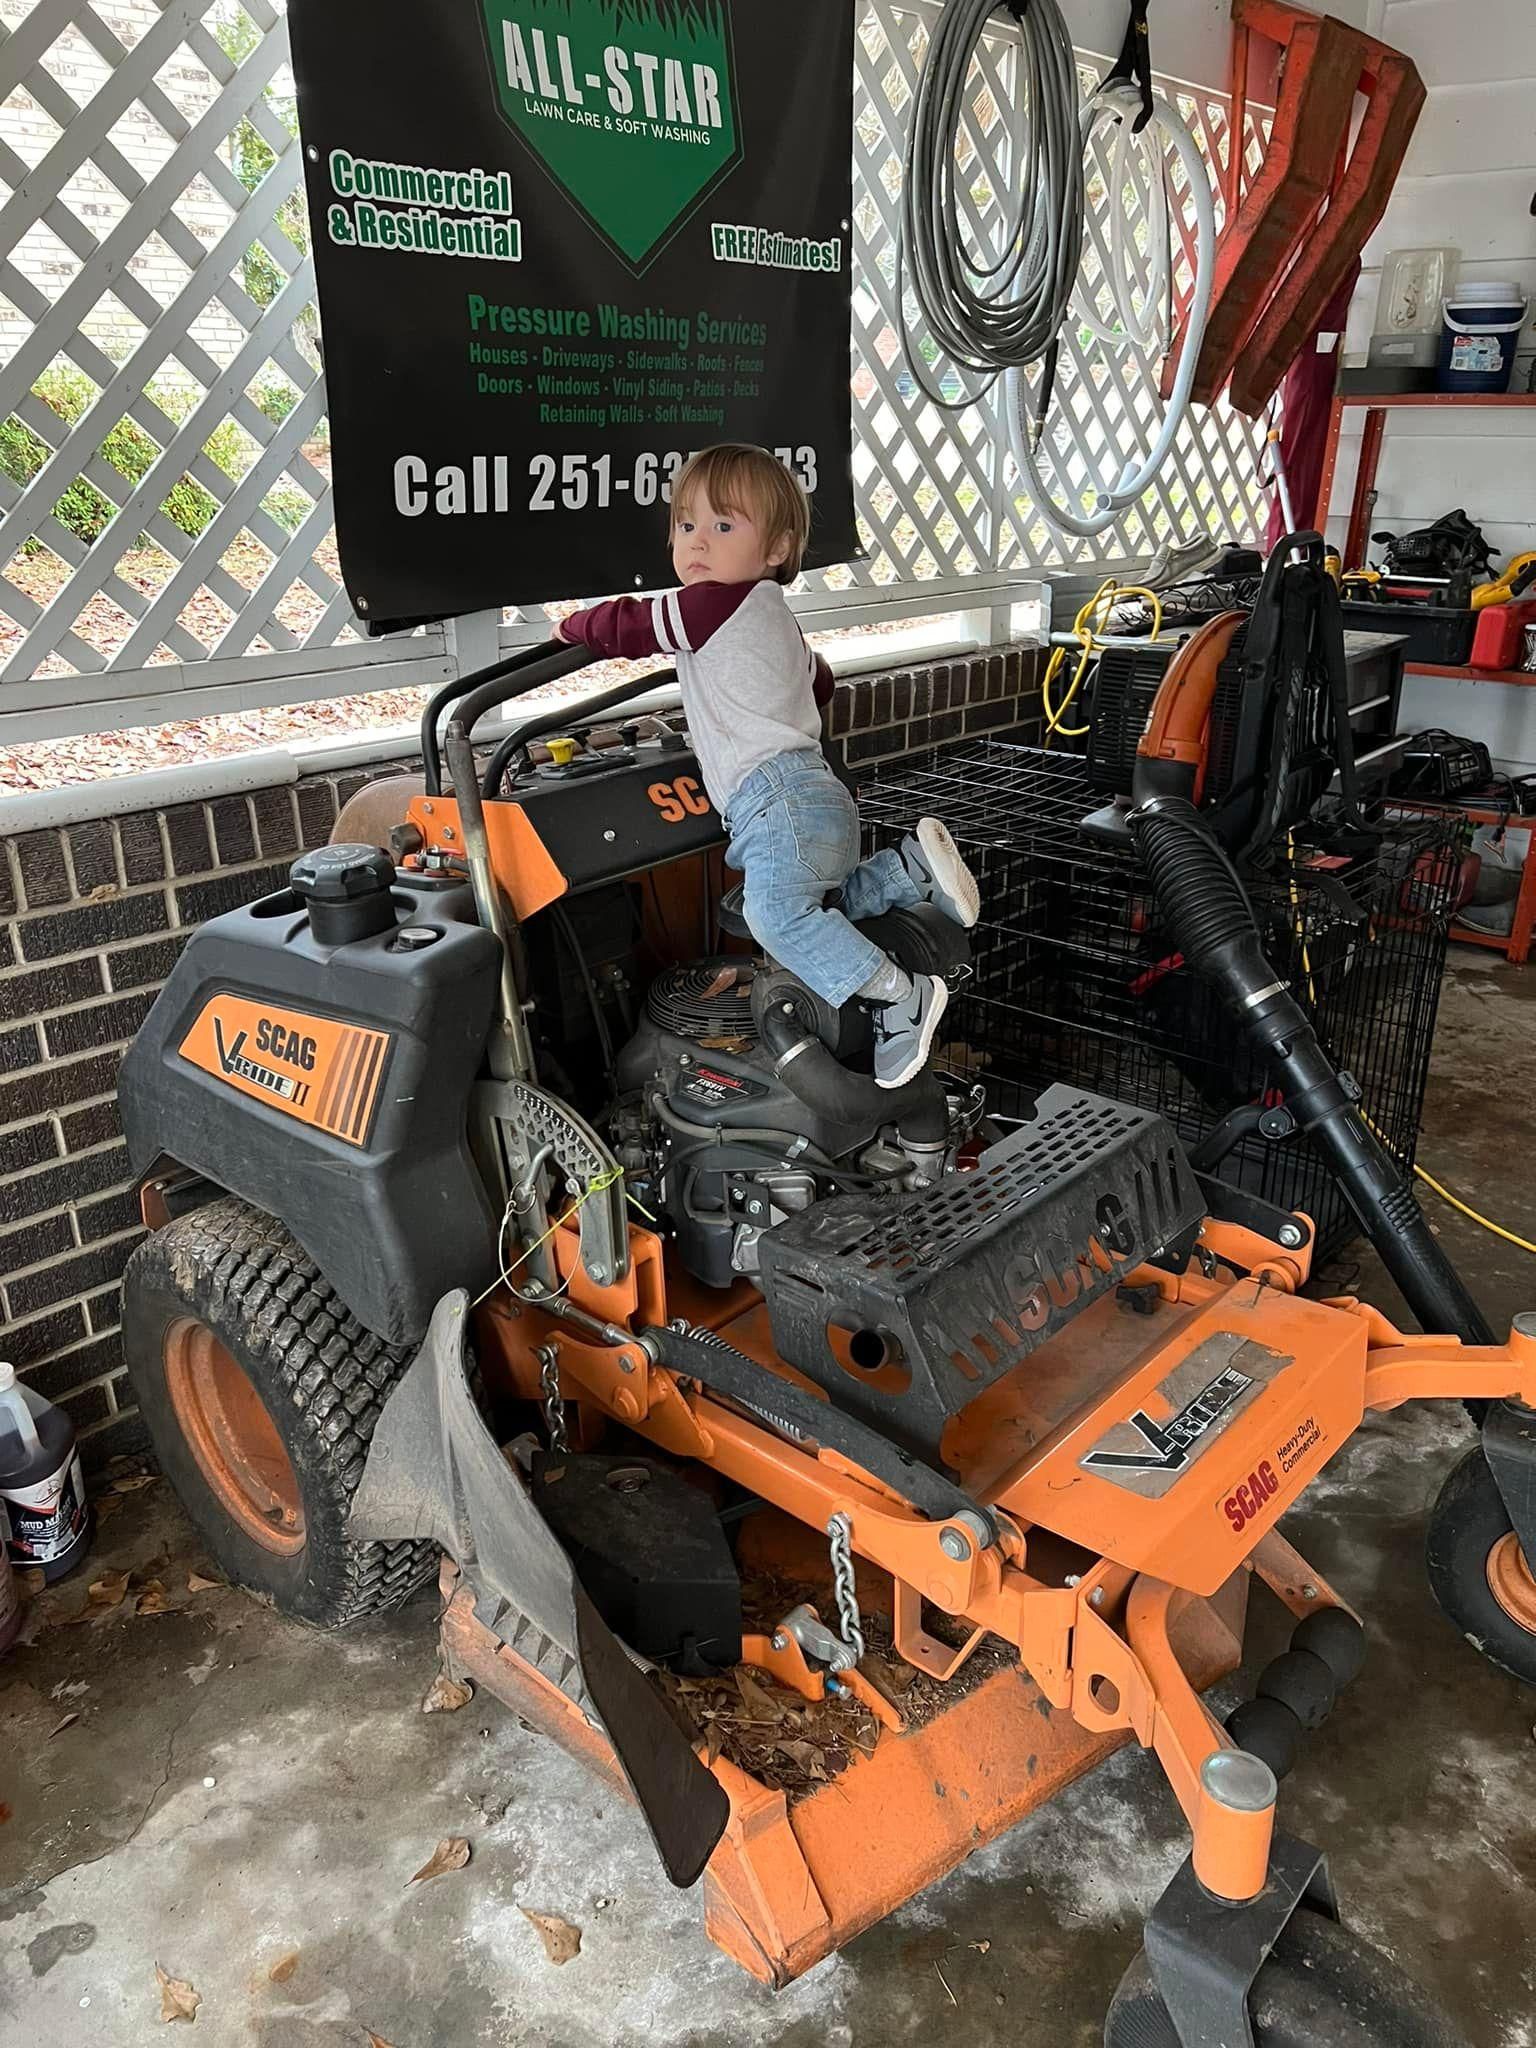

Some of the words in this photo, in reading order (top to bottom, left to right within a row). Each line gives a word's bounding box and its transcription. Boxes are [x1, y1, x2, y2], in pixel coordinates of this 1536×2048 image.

[503, 19, 722, 128] ALL-STAR
[525, 97, 569, 121] LAWN
[567, 108, 601, 129] CARE
[604, 117, 613, 130] &
[616, 117, 648, 137] SOFT
[650, 124, 711, 146] WASHING
[329, 149, 512, 215] Commercial
[328, 204, 357, 245] &
[354, 201, 522, 262] Residential
[711, 223, 757, 264] FREE
[757, 228, 841, 272] Estimates!
[468, 294, 591, 337] Pressure
[597, 303, 690, 350] Washing
[696, 311, 768, 346] Services
[470, 342, 529, 365] Houses
[542, 346, 615, 373] Driveways
[627, 350, 688, 371] Sidewalks
[697, 353, 727, 372] Roofs
[478, 372, 523, 394] Doors
[536, 375, 600, 395] Windows
[612, 377, 645, 401] Vinyl
[648, 378, 684, 401] Siding
[693, 379, 725, 397] Patios
[540, 403, 606, 427] Retaining
[609, 404, 644, 424] Walls
[655, 404, 677, 423] Soft
[681, 405, 725, 428] Washing
[394, 455, 509, 516] Call
[256, 1018, 317, 1071] SCAG
[1276, 1415, 1316, 1461] Heavy-Duty
[1282, 1425, 1322, 1473] Commercial
[1223, 1460, 1279, 1532] SCAG
